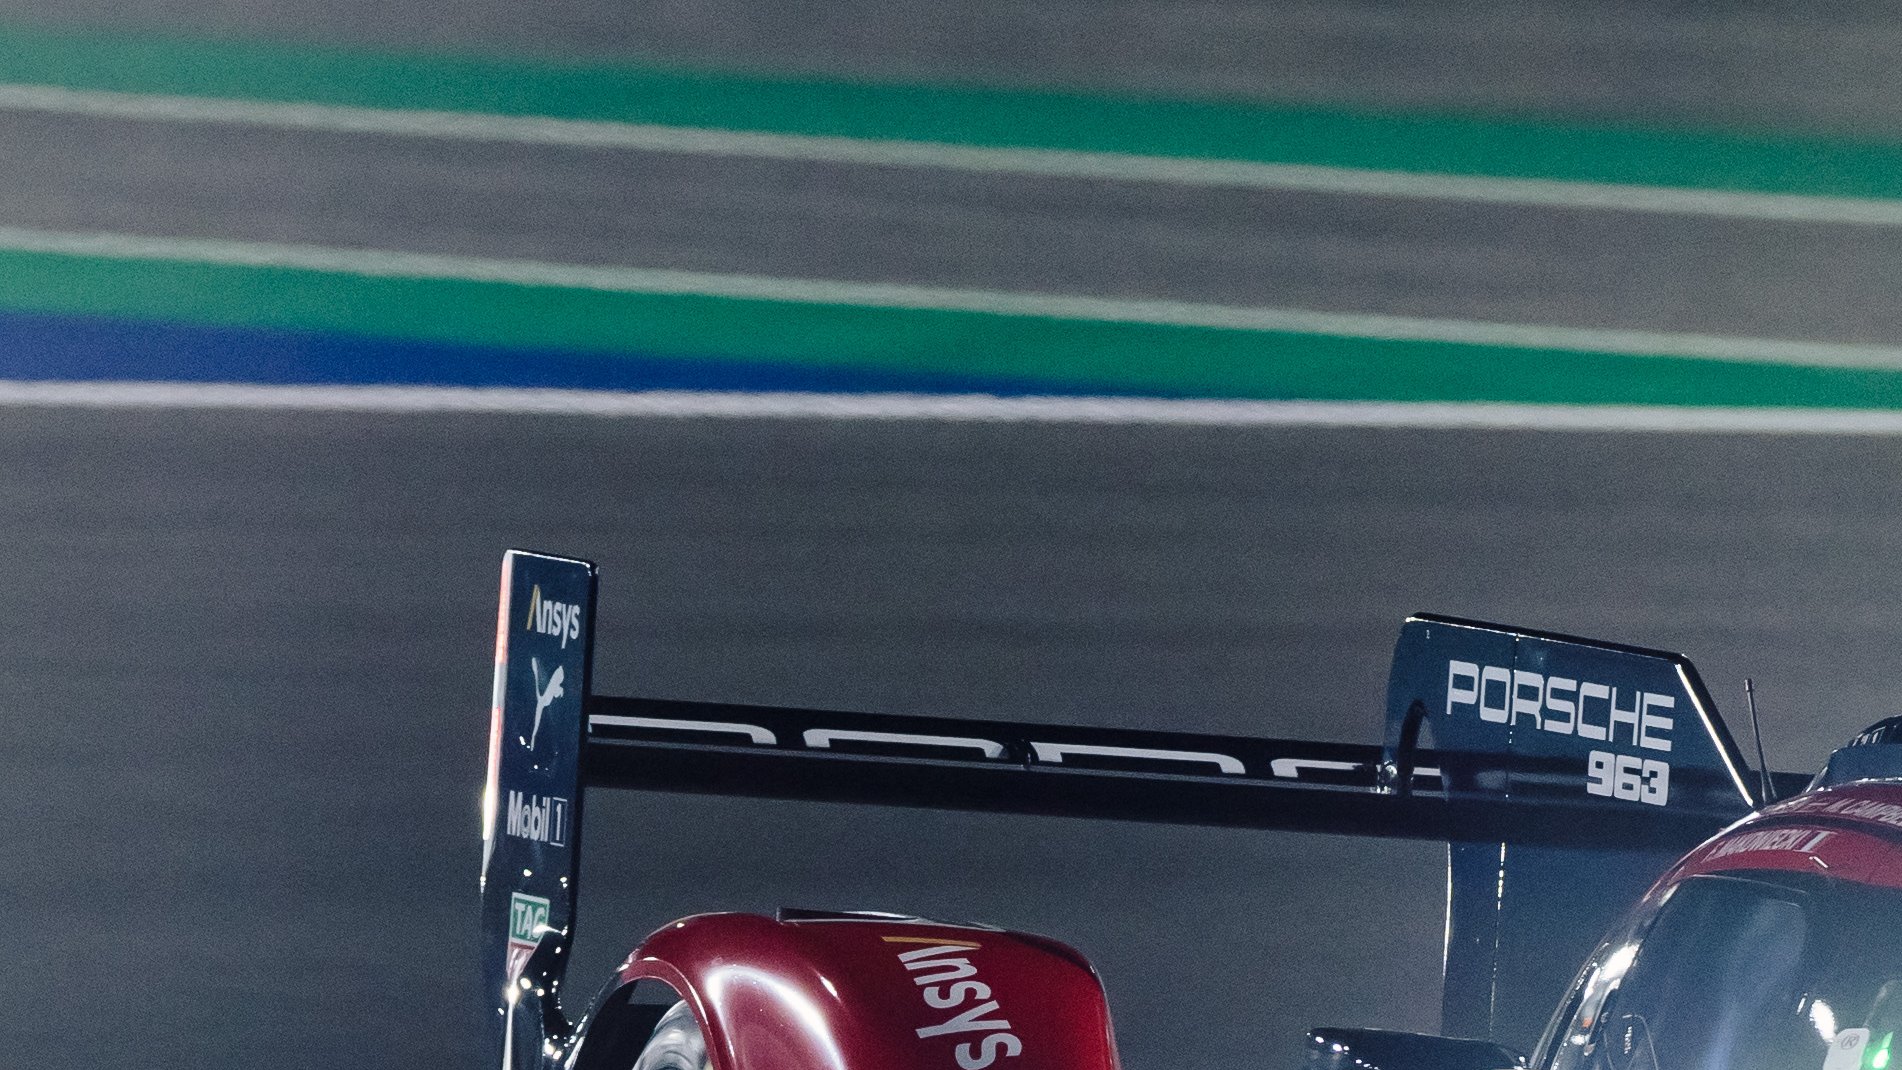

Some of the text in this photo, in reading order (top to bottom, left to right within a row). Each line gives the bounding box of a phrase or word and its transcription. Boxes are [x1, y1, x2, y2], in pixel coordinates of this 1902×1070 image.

[526, 584, 580, 649] Ansys
[1446, 660, 1675, 752] PORSCHE
[1586, 749, 1670, 807] 963
[506, 790, 550, 841] Mobil
[514, 902, 546, 939] TAG
[880, 935, 1023, 1070] Ansys
